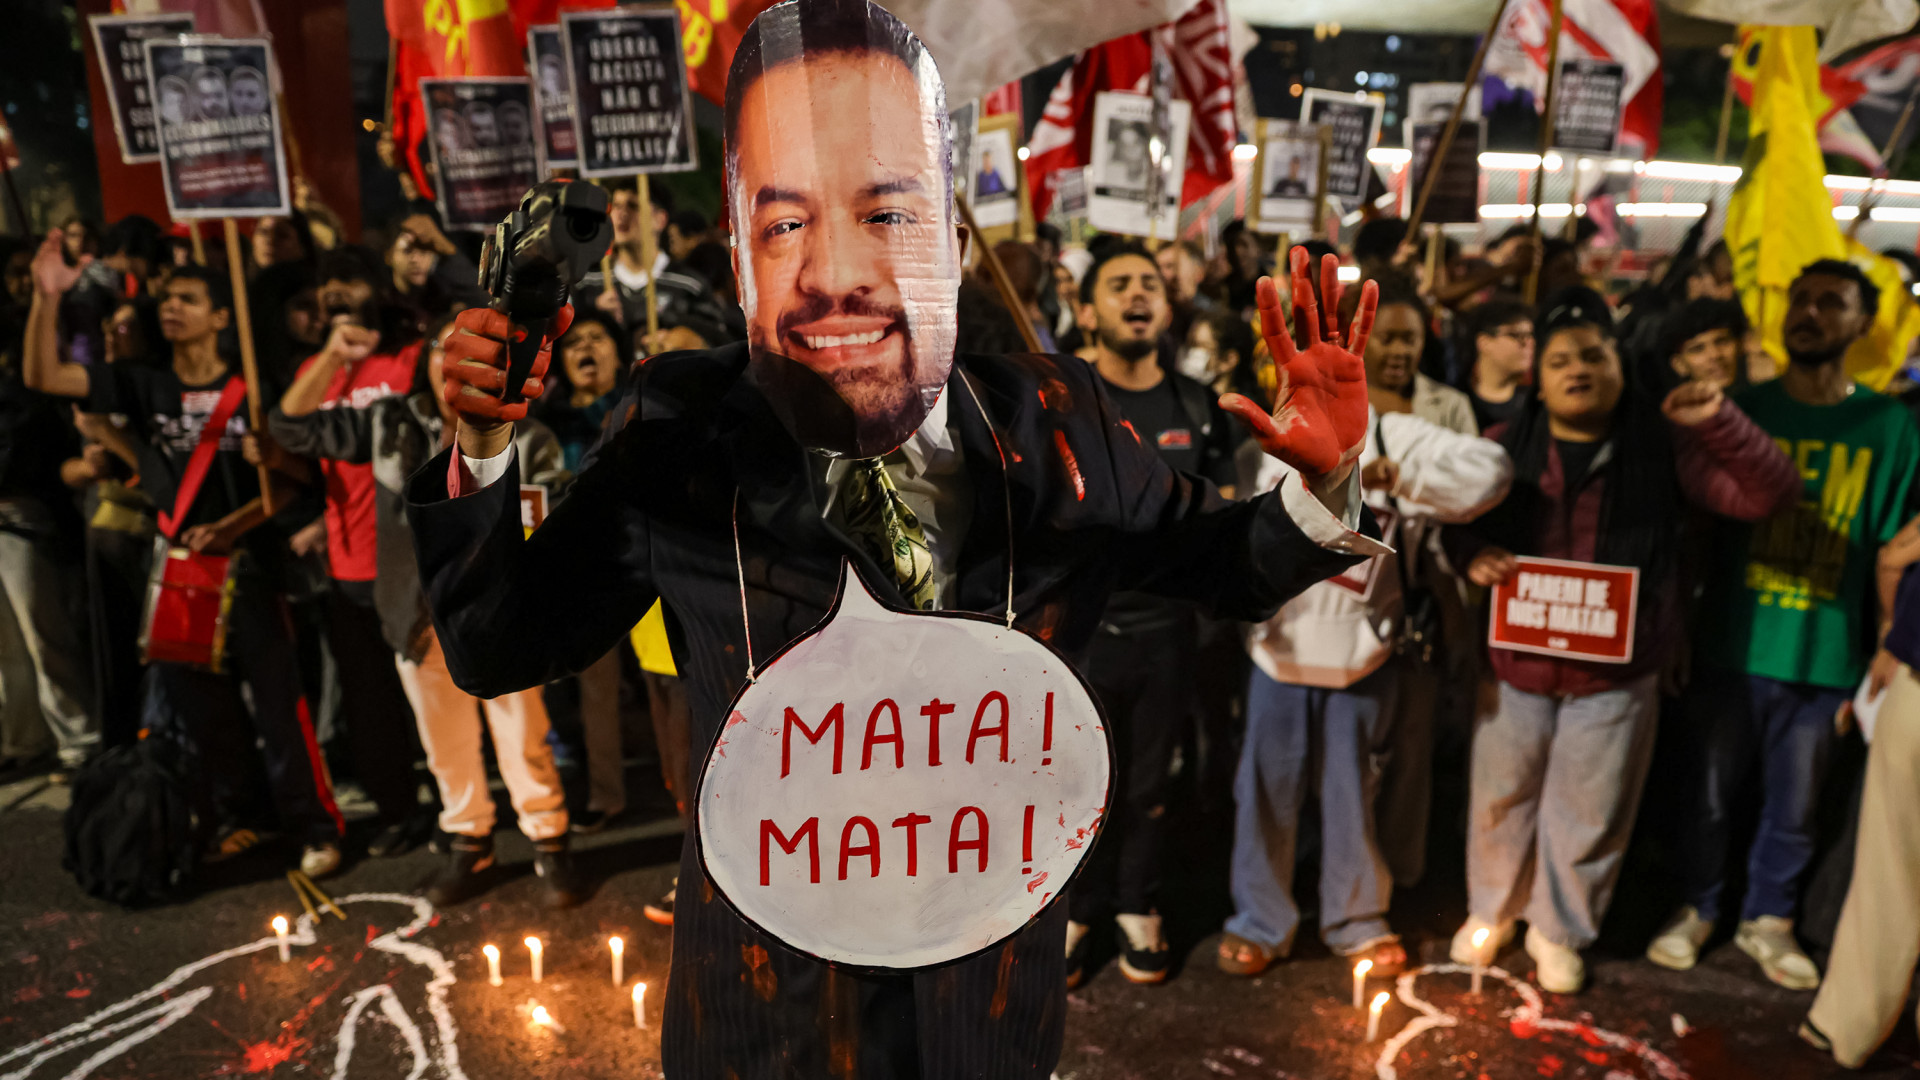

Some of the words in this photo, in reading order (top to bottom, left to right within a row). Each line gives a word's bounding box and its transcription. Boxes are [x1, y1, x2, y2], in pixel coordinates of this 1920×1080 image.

[589, 59, 666, 84] RACISTA
[1517, 571, 1584, 604] PAREM
[1585, 578, 1611, 609] DE
[1506, 597, 1547, 630] NOS
[1547, 604, 1618, 638] MATAR
[781, 691, 1054, 779] MATA!
[760, 805, 1035, 887] MATA!
